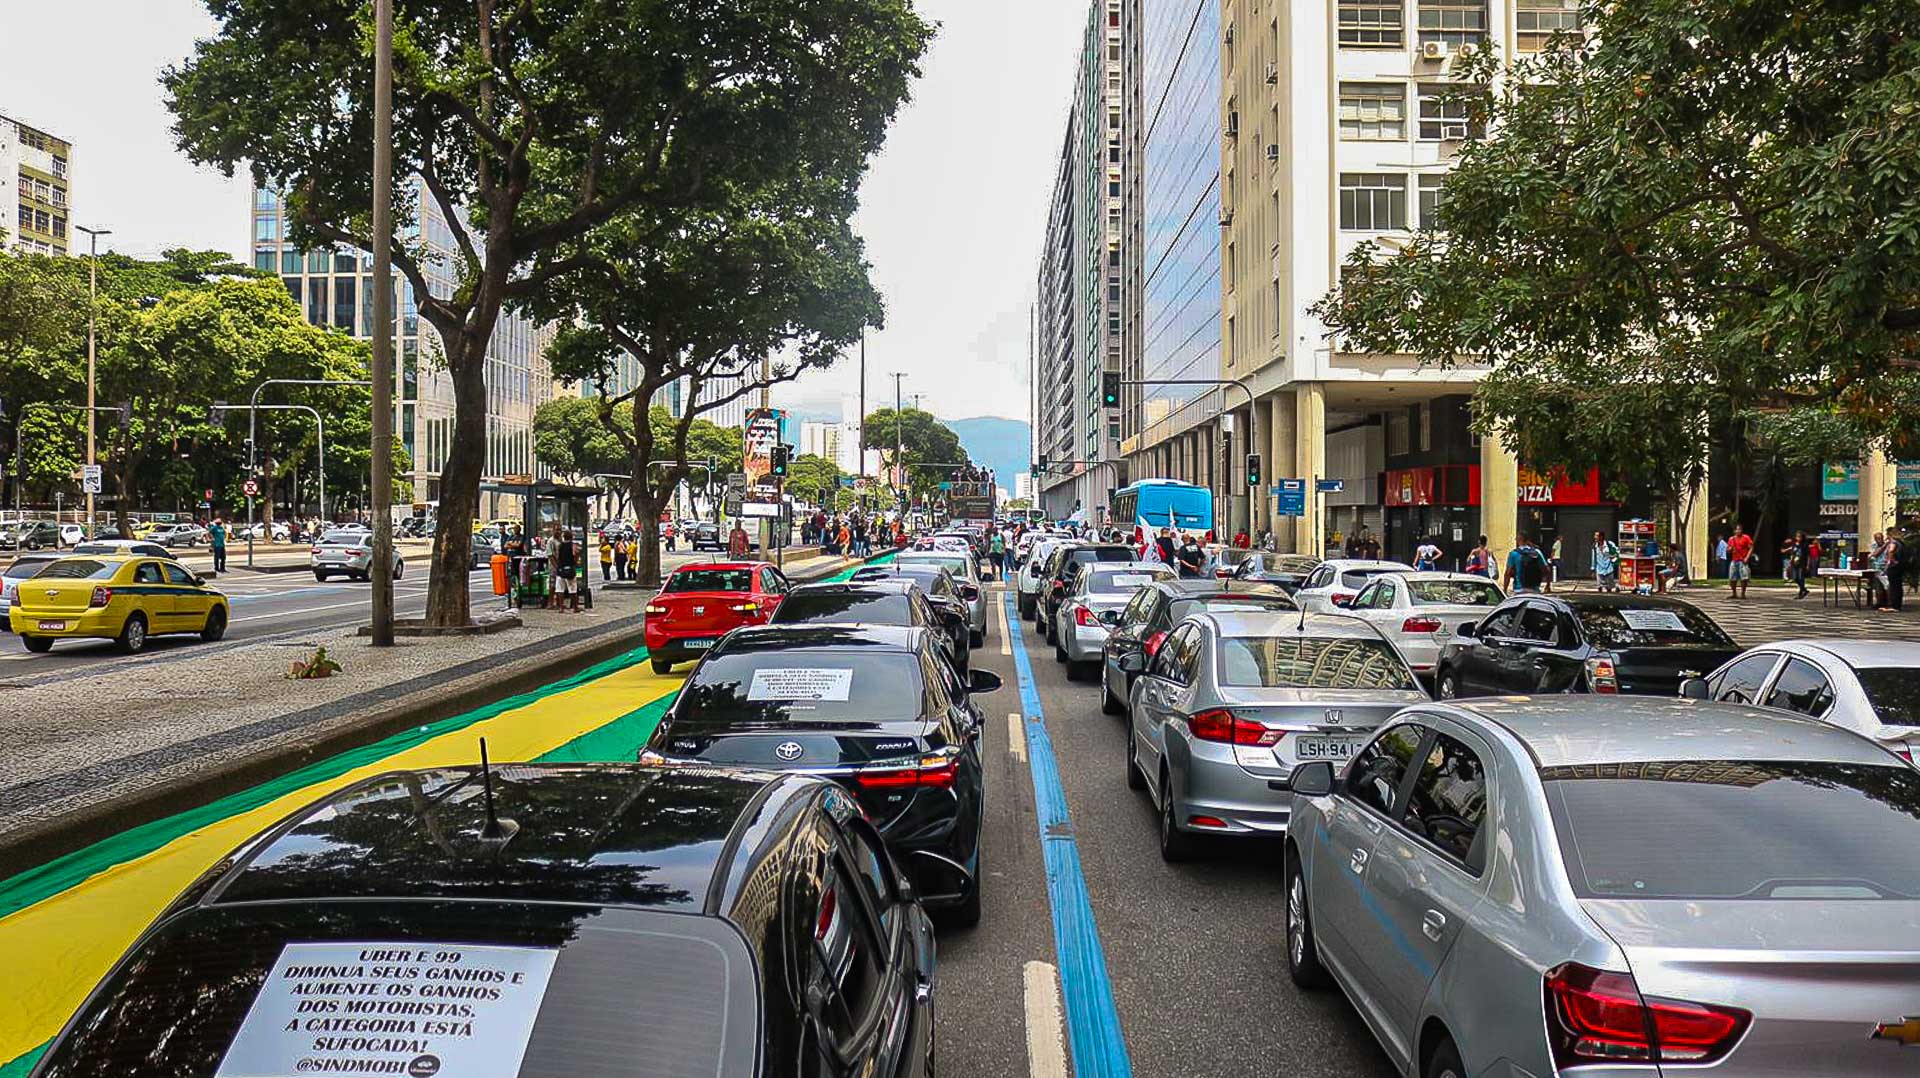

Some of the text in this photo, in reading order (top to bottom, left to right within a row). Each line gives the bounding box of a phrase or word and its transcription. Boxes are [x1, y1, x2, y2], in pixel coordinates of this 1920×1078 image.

[1517, 485, 1553, 502] PIZZA
[360, 950, 462, 963] UBER E 99
[284, 965, 525, 985] DIMINUA SEUS GANHOS E
[290, 983, 502, 1001] AUMENTE OS GANHOS
[297, 1000, 340, 1013] DOS
[284, 1018, 299, 1032] A
[305, 1018, 416, 1033] CATEGORIA
[312, 1037, 428, 1053] SUFOCADA!
[296, 1057, 407, 1073] @SINDMOBI
